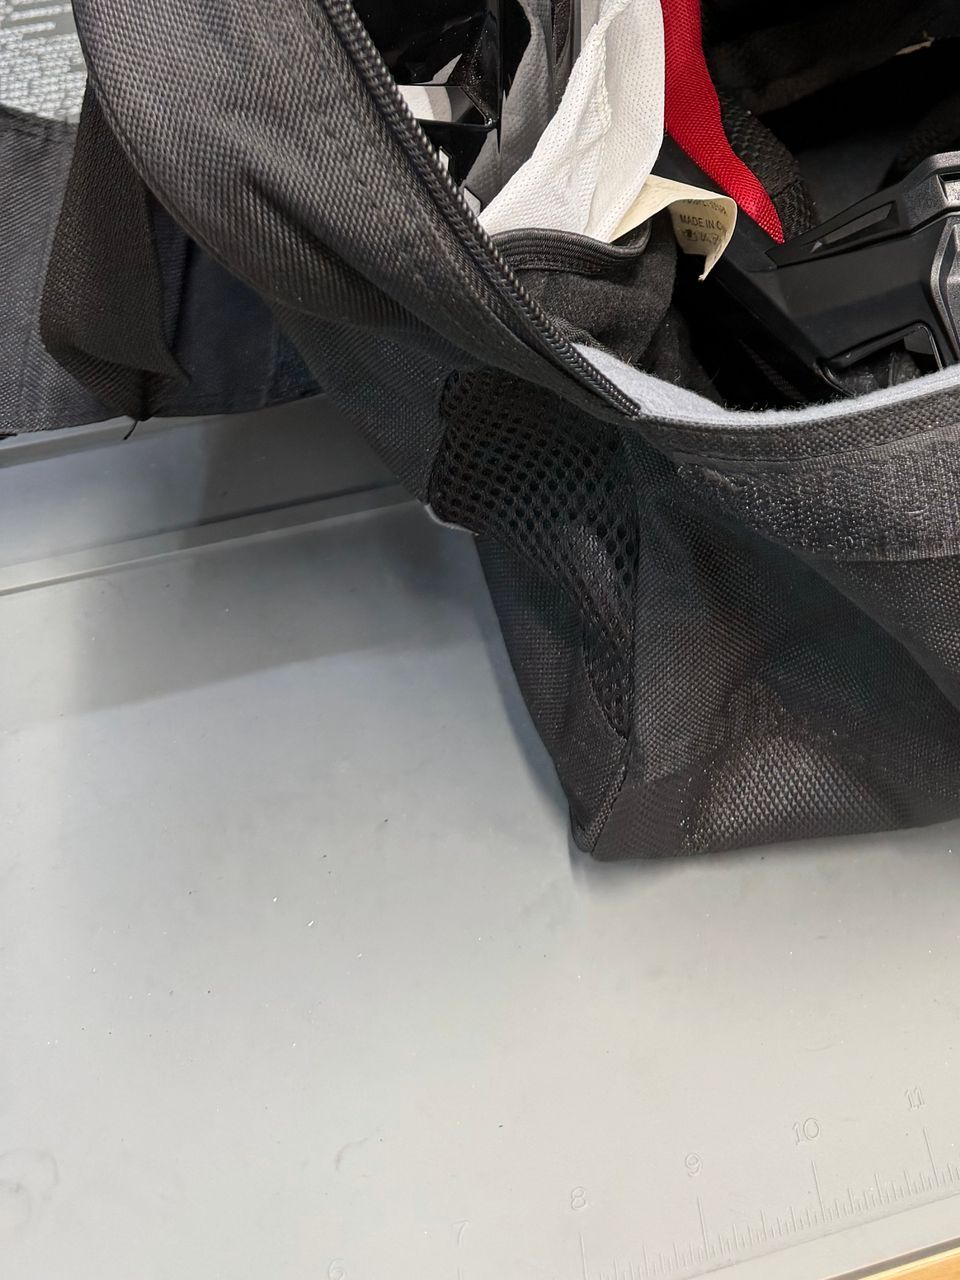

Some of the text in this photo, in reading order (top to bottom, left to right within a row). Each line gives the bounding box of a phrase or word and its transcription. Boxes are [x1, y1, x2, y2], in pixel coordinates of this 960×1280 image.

[679, 214, 705, 229] MADE
[705, 218, 715, 230] IN
[570, 1185, 588, 1211] 8
[684, 1152, 704, 1177] 9
[792, 1117, 821, 1145] 10
[904, 1086, 926, 1111] 11
